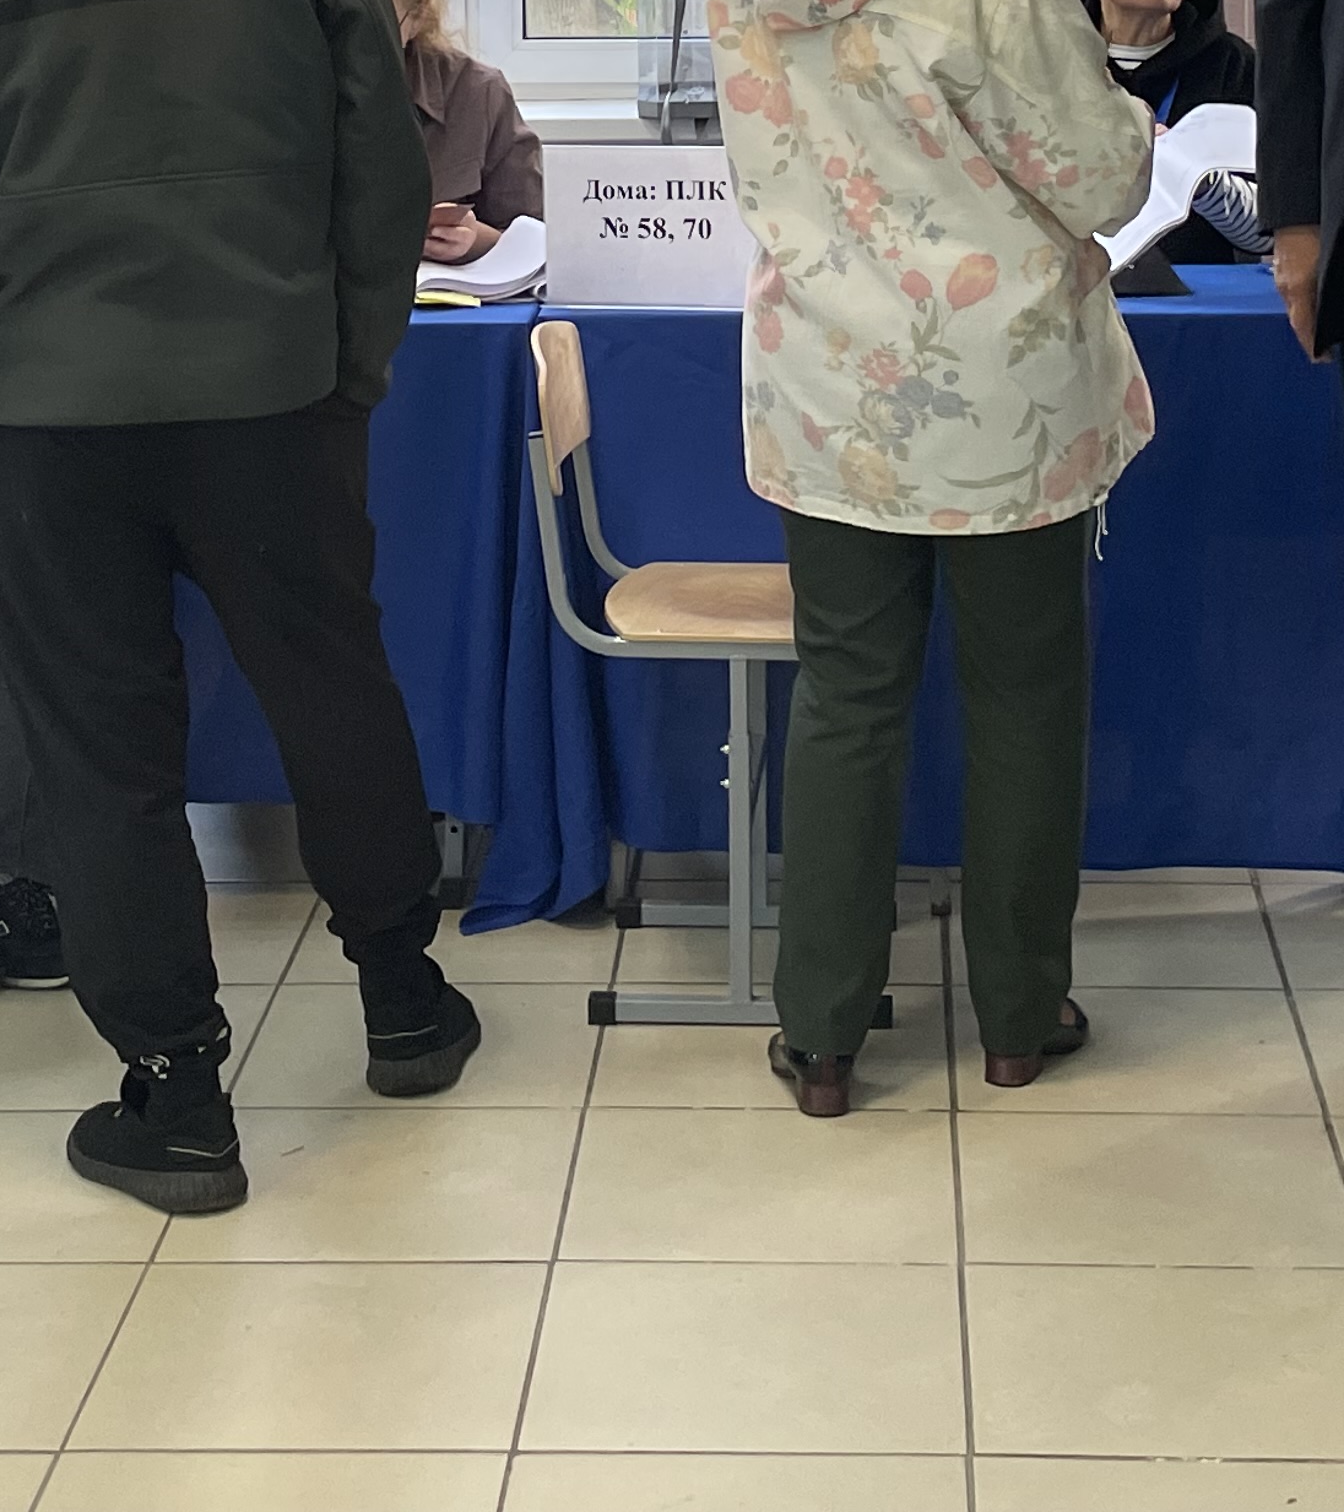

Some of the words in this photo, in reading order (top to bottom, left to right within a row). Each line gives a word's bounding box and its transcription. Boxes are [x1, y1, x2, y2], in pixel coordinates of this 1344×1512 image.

[583, 179, 656, 204] Дома:
[666, 179, 728, 201] ПЛК
[599, 216, 629, 240] №
[637, 217, 675, 244] 58,
[682, 217, 712, 240] 70
